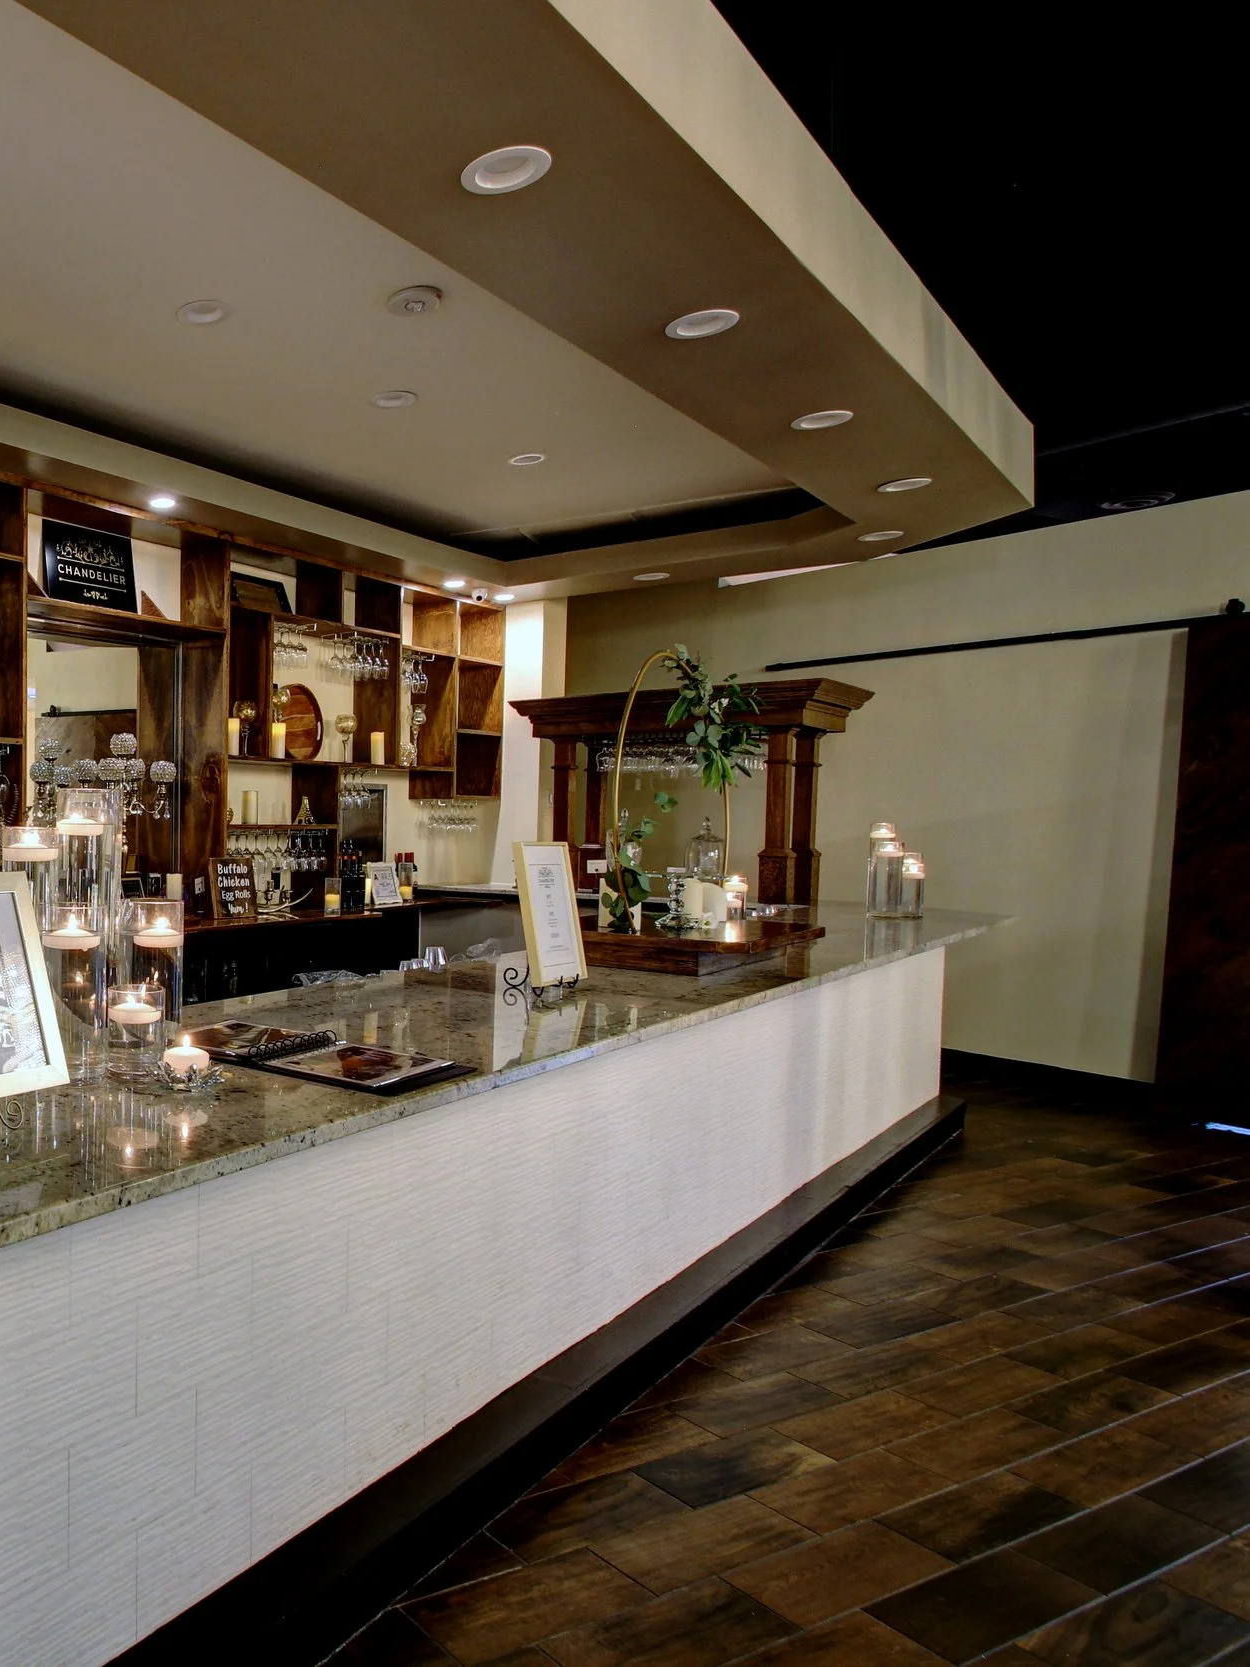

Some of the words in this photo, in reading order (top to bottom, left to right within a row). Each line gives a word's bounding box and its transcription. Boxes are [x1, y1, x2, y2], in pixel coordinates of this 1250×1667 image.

[57, 563, 126, 585] CHANDELIER
[217, 863, 248, 875] Buffalo
[217, 876, 250, 888] Chicken
[221, 890, 234, 901] Egg
[235, 890, 251, 899] Rolls
